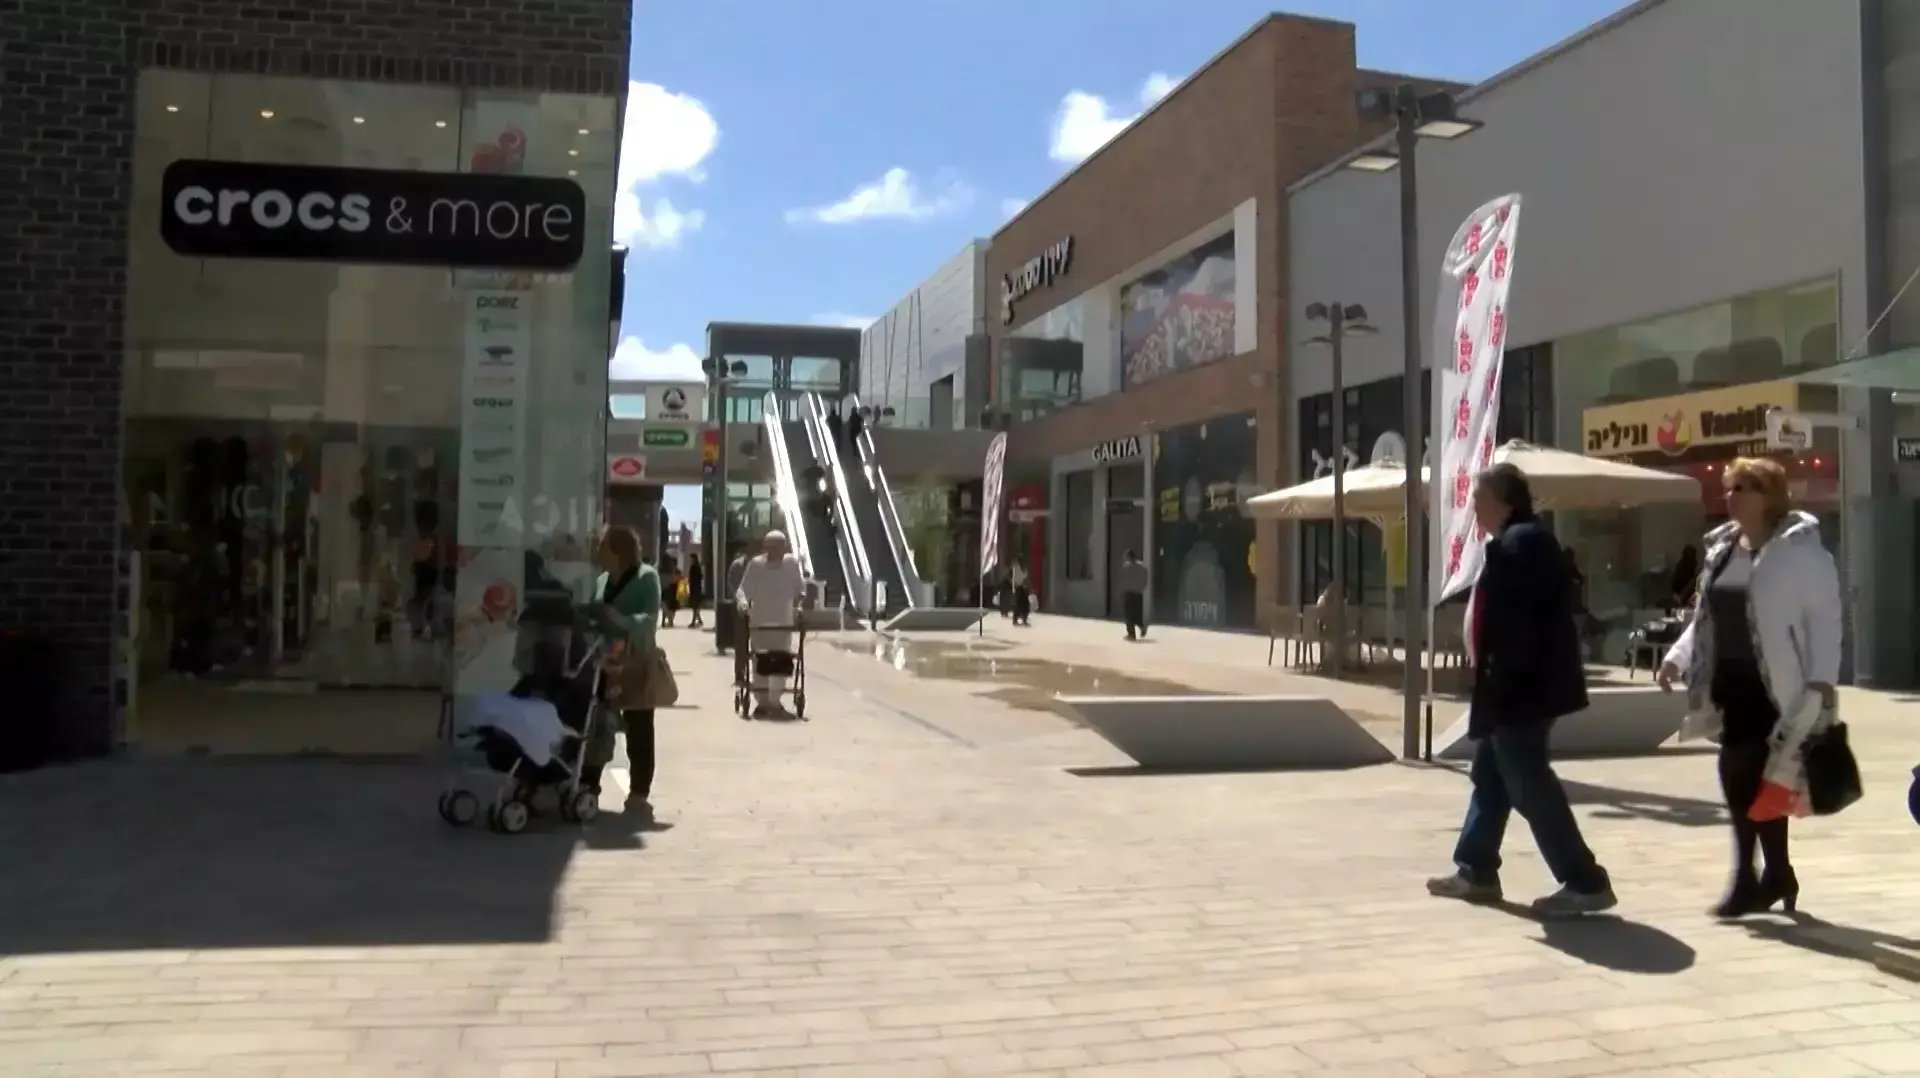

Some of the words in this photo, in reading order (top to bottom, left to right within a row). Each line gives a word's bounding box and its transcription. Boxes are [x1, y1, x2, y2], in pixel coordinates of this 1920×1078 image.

[175, 185, 372, 233] crocs
[385, 196, 414, 235] &
[428, 197, 573, 242] more
[1091, 436, 1141, 462] GALITA
[1587, 421, 1649, 451] וניליה
